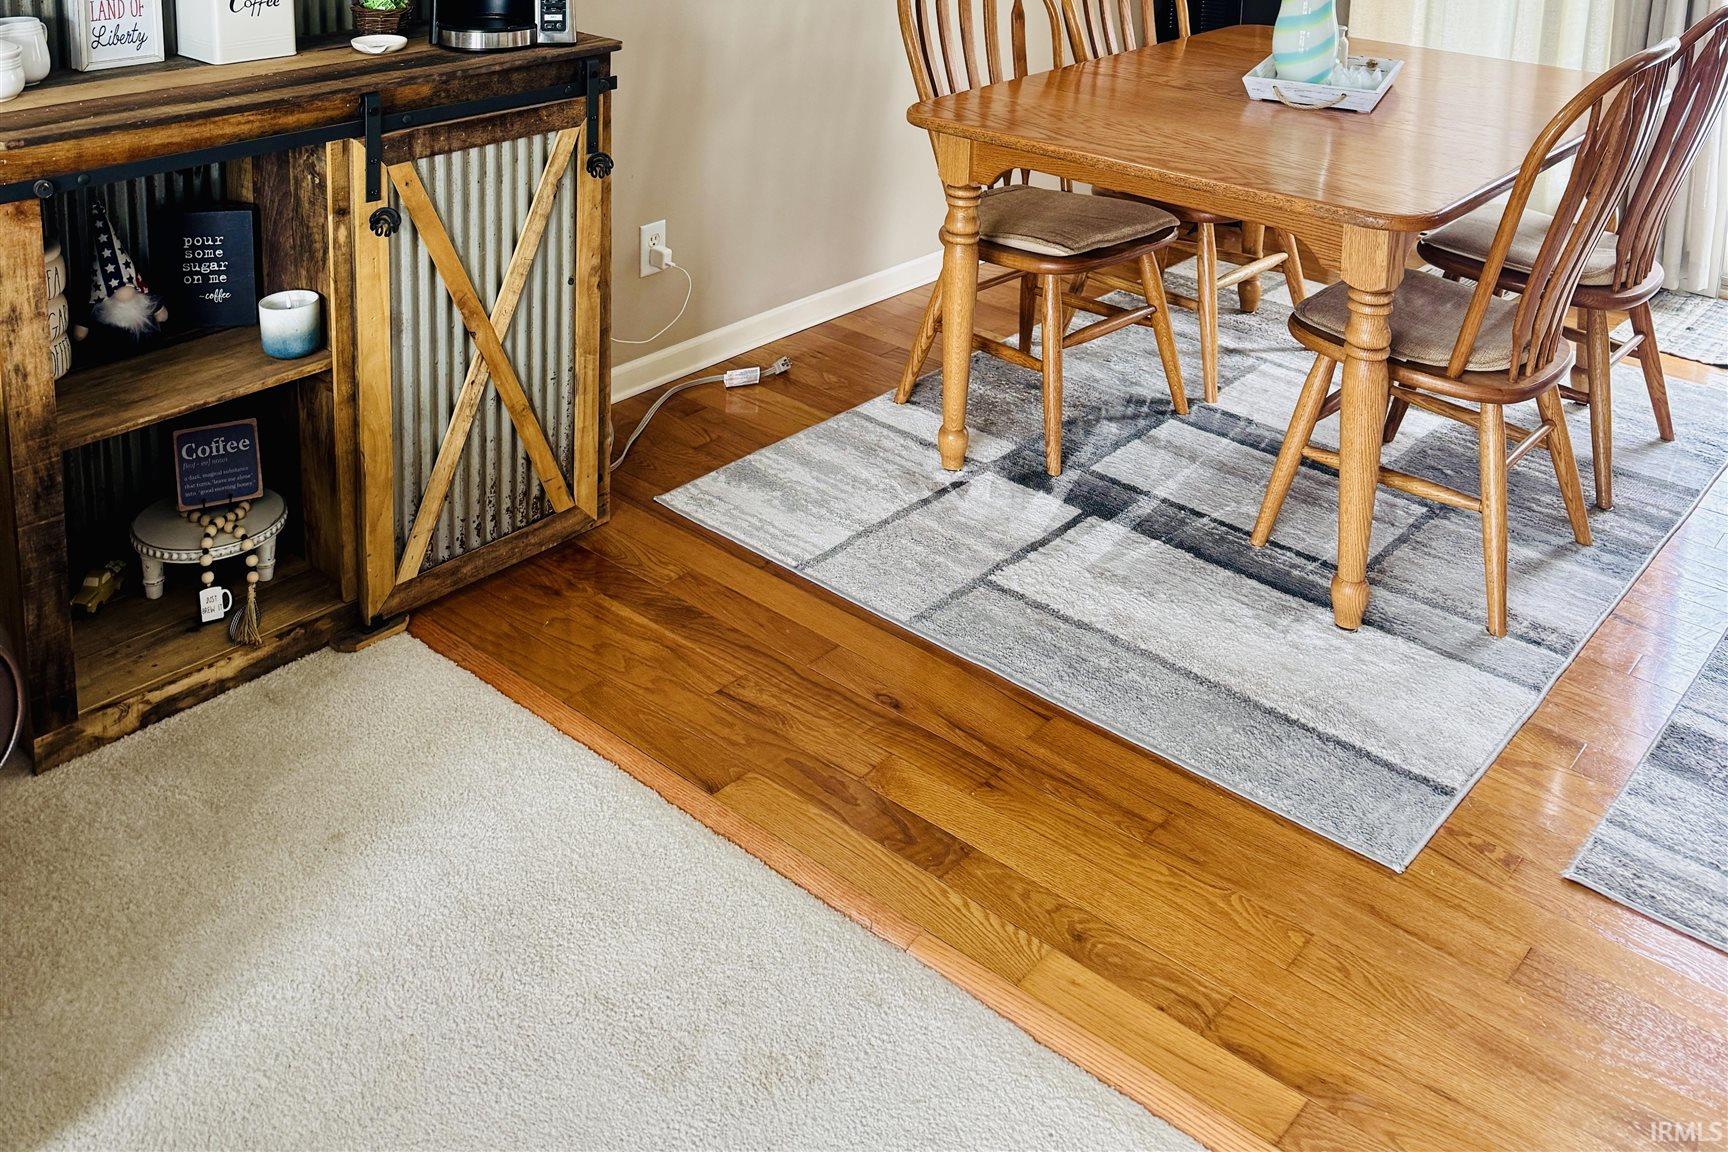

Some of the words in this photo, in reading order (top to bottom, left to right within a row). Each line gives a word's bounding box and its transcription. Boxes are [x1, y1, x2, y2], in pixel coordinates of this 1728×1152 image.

[89, 0, 126, 22] LAND
[91, 22, 149, 51] Liberty
[183, 236, 224, 248] pour
[184, 249, 224, 259] some
[182, 261, 228, 274] sugar
[183, 275, 203, 284] on
[208, 274, 228, 284] me
[181, 437, 250, 460] Coffee
